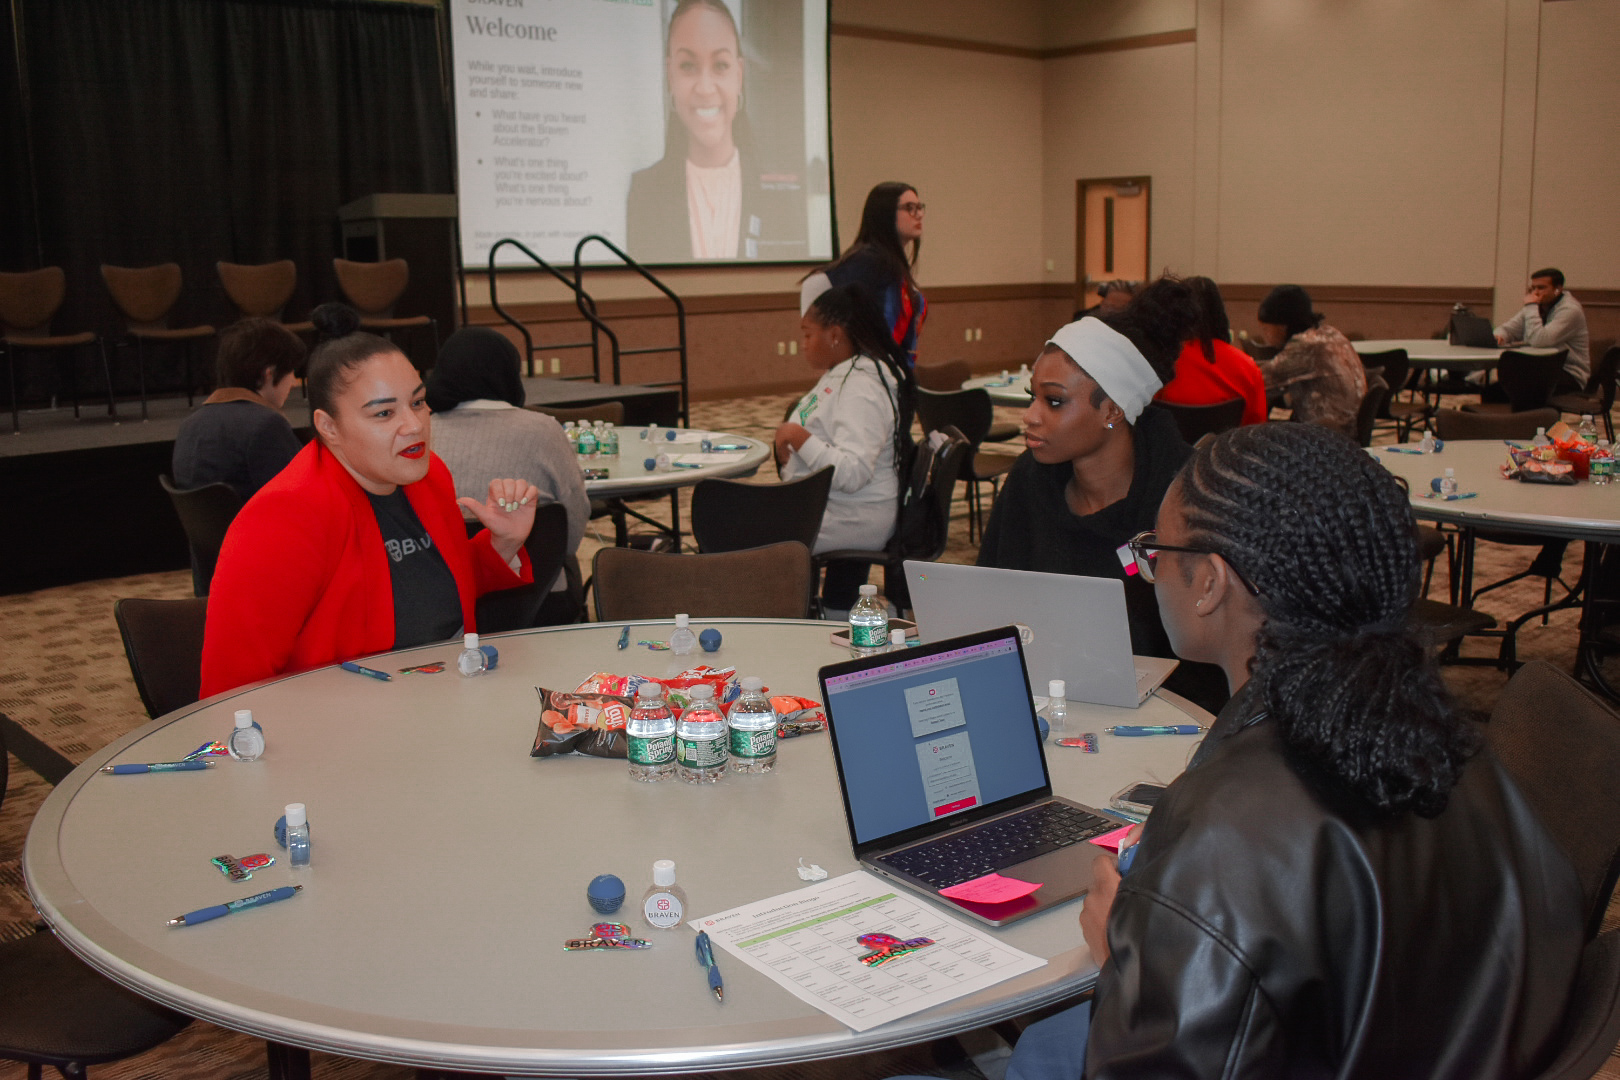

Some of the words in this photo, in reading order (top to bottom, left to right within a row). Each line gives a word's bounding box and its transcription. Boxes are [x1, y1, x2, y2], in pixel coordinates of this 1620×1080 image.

[466, 14, 558, 41] Welcome
[467, 60, 495, 73] While
[497, 63, 515, 75] you
[517, 64, 539, 76] wait,
[541, 65, 583, 78] introduce
[468, 75, 507, 87] yourself
[509, 77, 519, 87] to
[520, 79, 562, 90] someone
[564, 82, 583, 91] new
[469, 88, 487, 99] and
[492, 109, 517, 121] What
[518, 110, 541, 122] have
[543, 113, 560, 124] you
[561, 112, 587, 124] heard
[493, 122, 519, 134] about
[520, 123, 535, 134] the
[537, 124, 569, 136] Braven
[493, 135, 550, 147] Accelerator?
[494, 156, 525, 168] What's
[527, 159, 544, 169] one
[547, 157, 569, 171] thing
[525, 171, 557, 182] excited
[559, 171, 589, 182] about?
[495, 182, 526, 194] What's
[528, 184, 545, 194] one
[547, 183, 569, 197] thing
[526, 197, 561, 207] nervous
[563, 196, 593, 207] about?
[604, 704, 625, 728] Lay's
[646, 737, 672, 752] Poland
[750, 730, 775, 746] Poland
[648, 744, 673, 761] Spring
[751, 738, 775, 754] Spring
[216, 855, 248, 880] BRAVEN
[245, 892, 272, 903] BRAVEN
[648, 911, 680, 919] BRAVEN
[715, 912, 741, 923] BRAVEN
[569, 938, 647, 949] BRAVEN
[864, 937, 930, 966] BRAVEN
